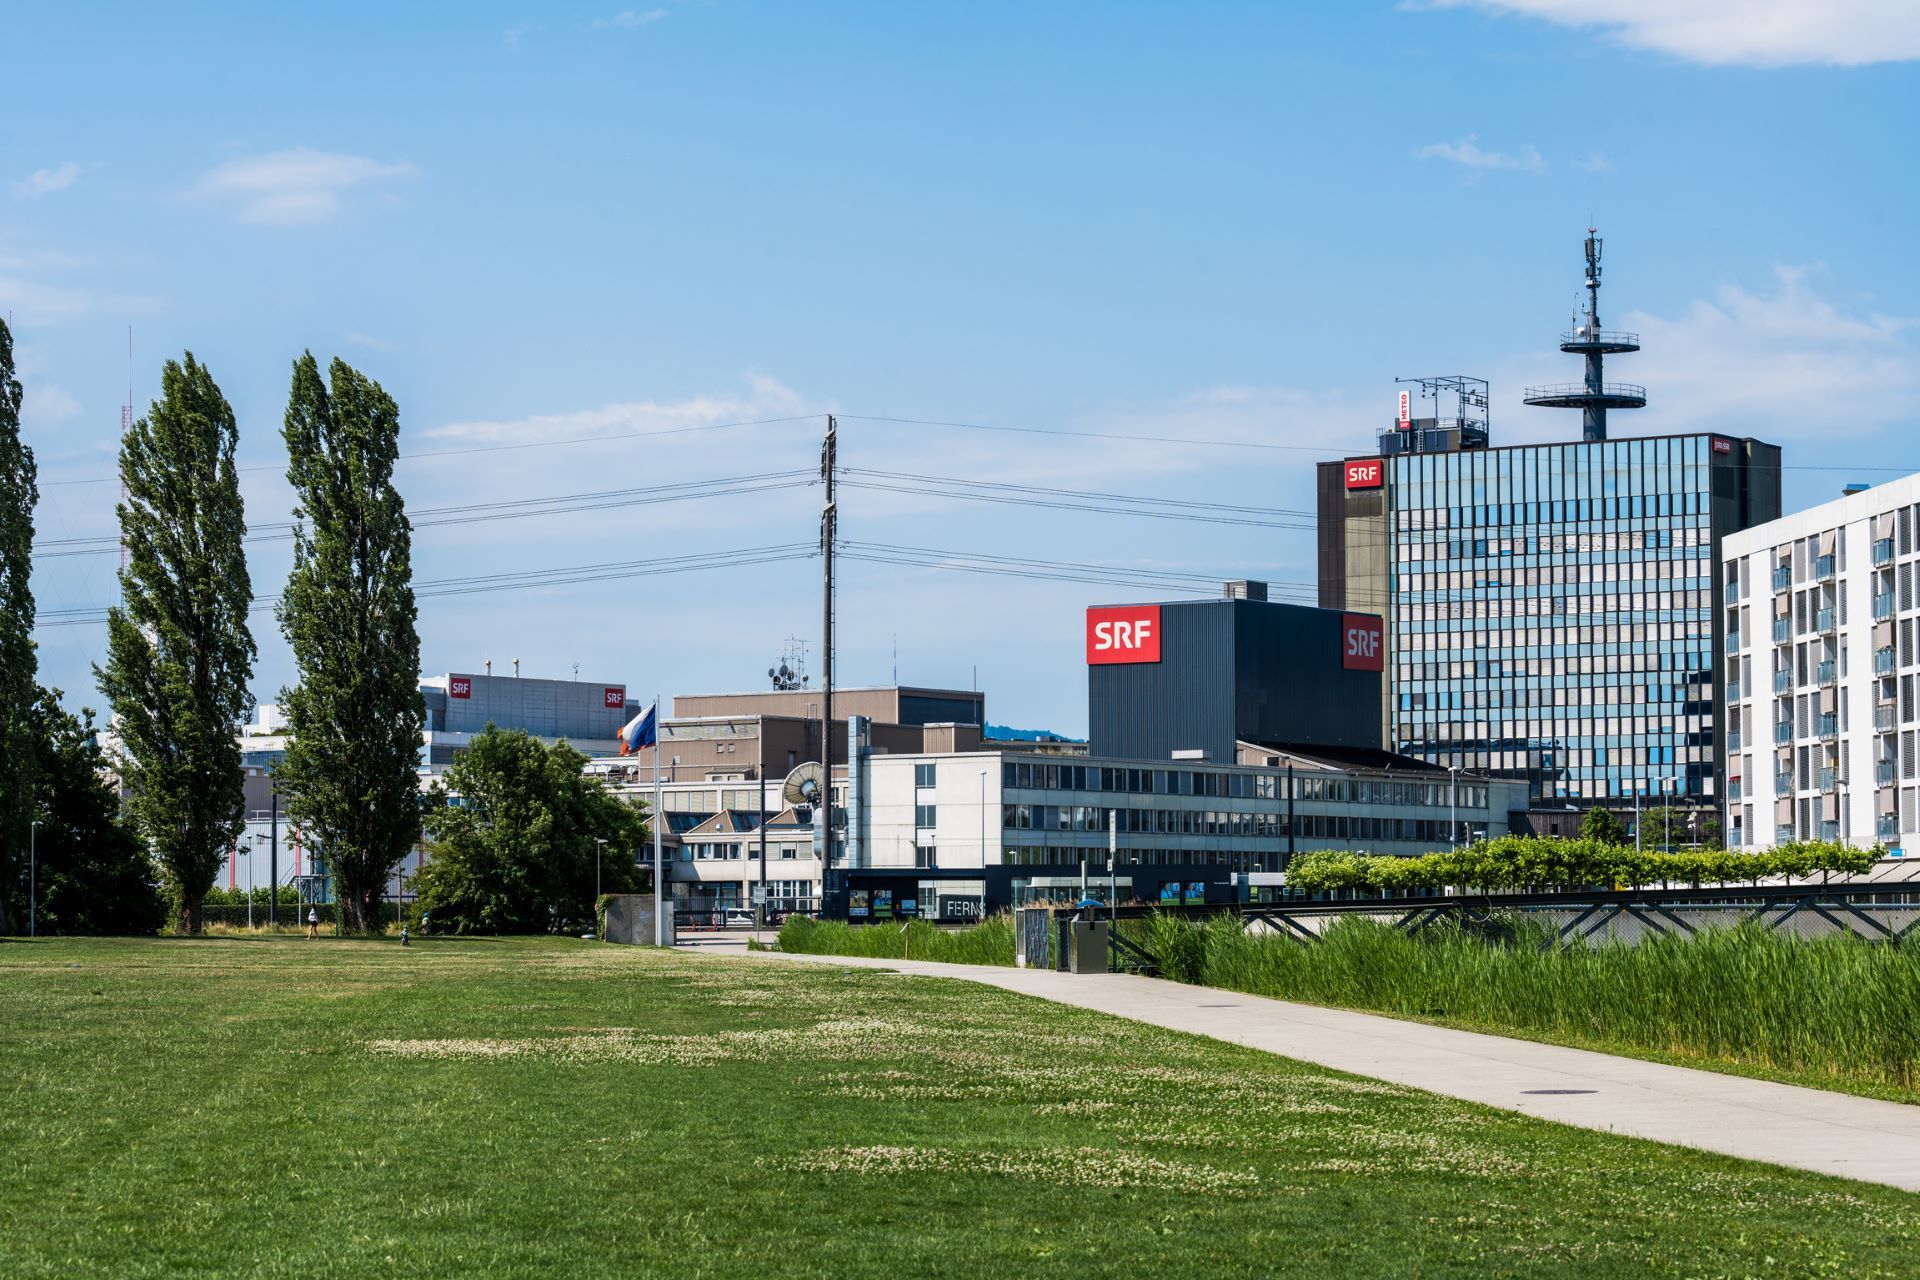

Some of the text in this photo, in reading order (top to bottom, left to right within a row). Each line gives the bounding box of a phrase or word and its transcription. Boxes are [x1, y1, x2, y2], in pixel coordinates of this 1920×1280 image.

[1349, 466, 1377, 482] SRF
[1095, 620, 1151, 650] SRF
[1347, 628, 1379, 657] SRF
[452, 682, 469, 694] SRF
[607, 692, 622, 704] SRF
